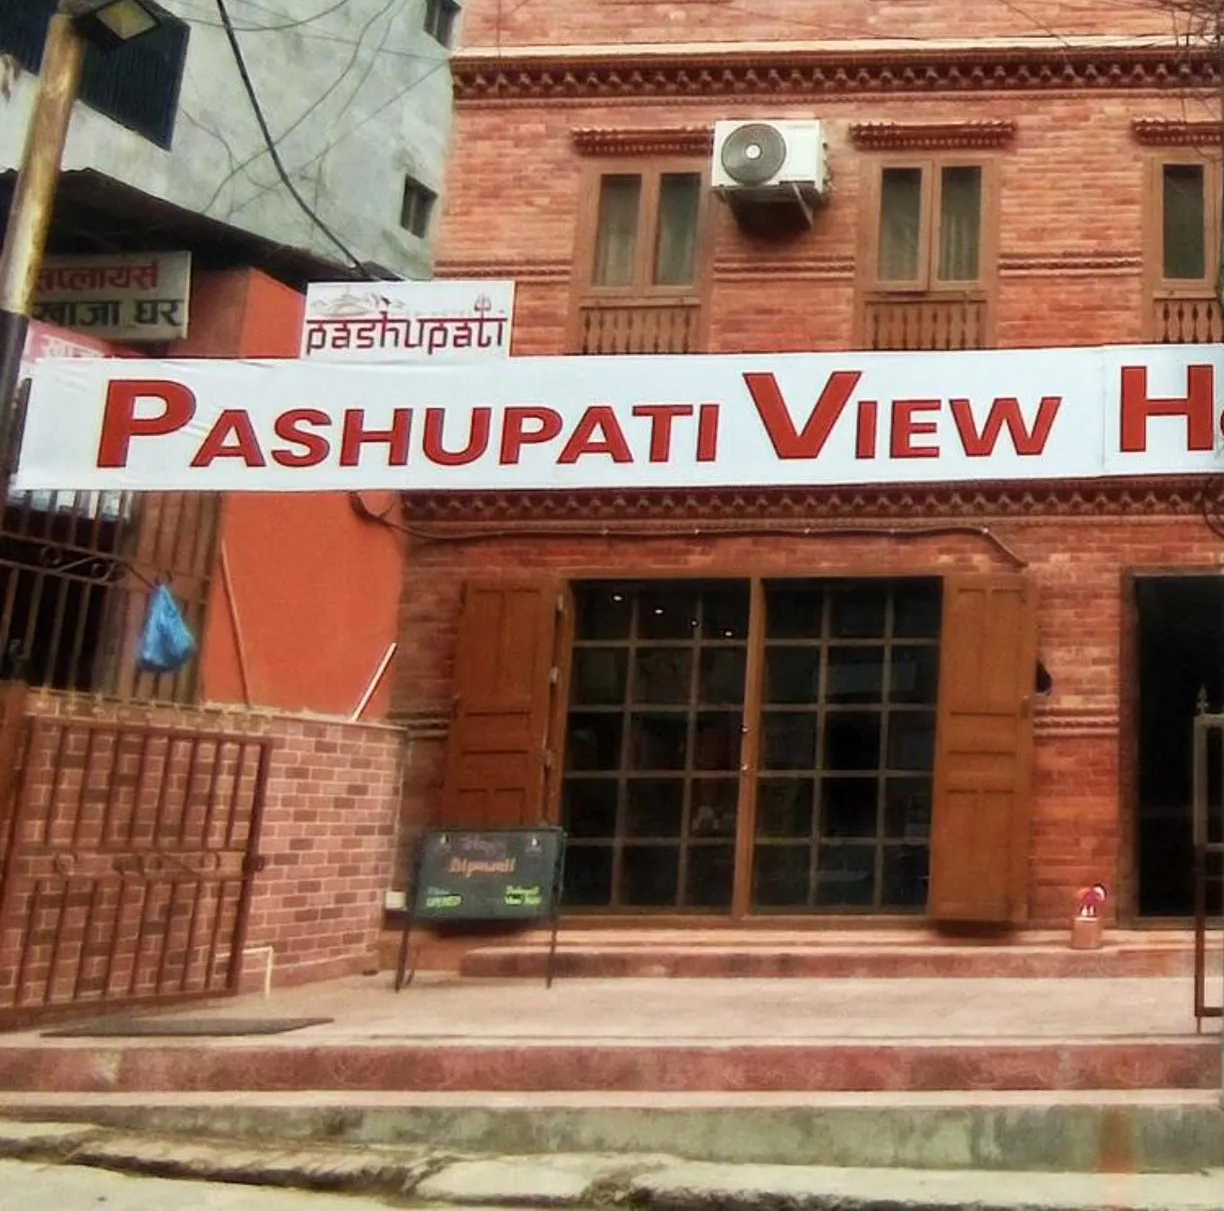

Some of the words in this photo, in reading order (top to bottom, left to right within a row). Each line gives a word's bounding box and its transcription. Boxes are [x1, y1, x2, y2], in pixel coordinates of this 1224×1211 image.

[132, 298, 184, 327] घर
[97, 379, 719, 468] PASHUPATI
[744, 371, 1060, 460] VIEW
